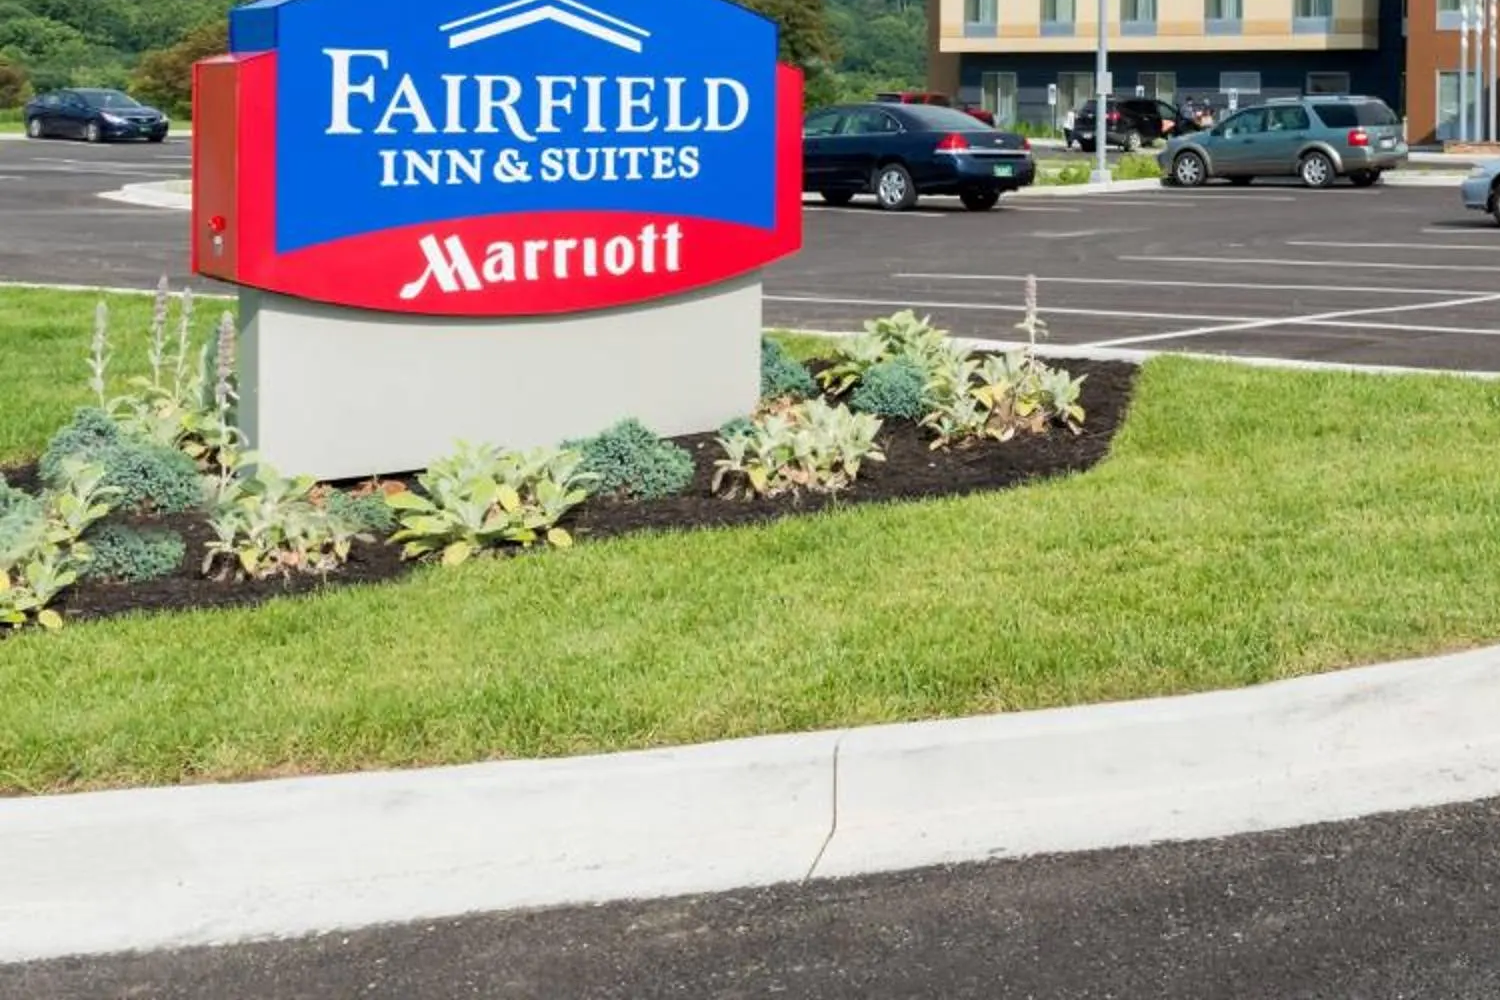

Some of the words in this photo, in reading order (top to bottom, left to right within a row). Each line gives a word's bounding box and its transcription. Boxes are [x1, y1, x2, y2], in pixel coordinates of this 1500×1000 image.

[321, 47, 750, 143] FAIRFIELD
[379, 149, 484, 186] INN
[493, 148, 532, 184] &
[540, 145, 700, 182] SUITES
[399, 222, 684, 300] Marriott
